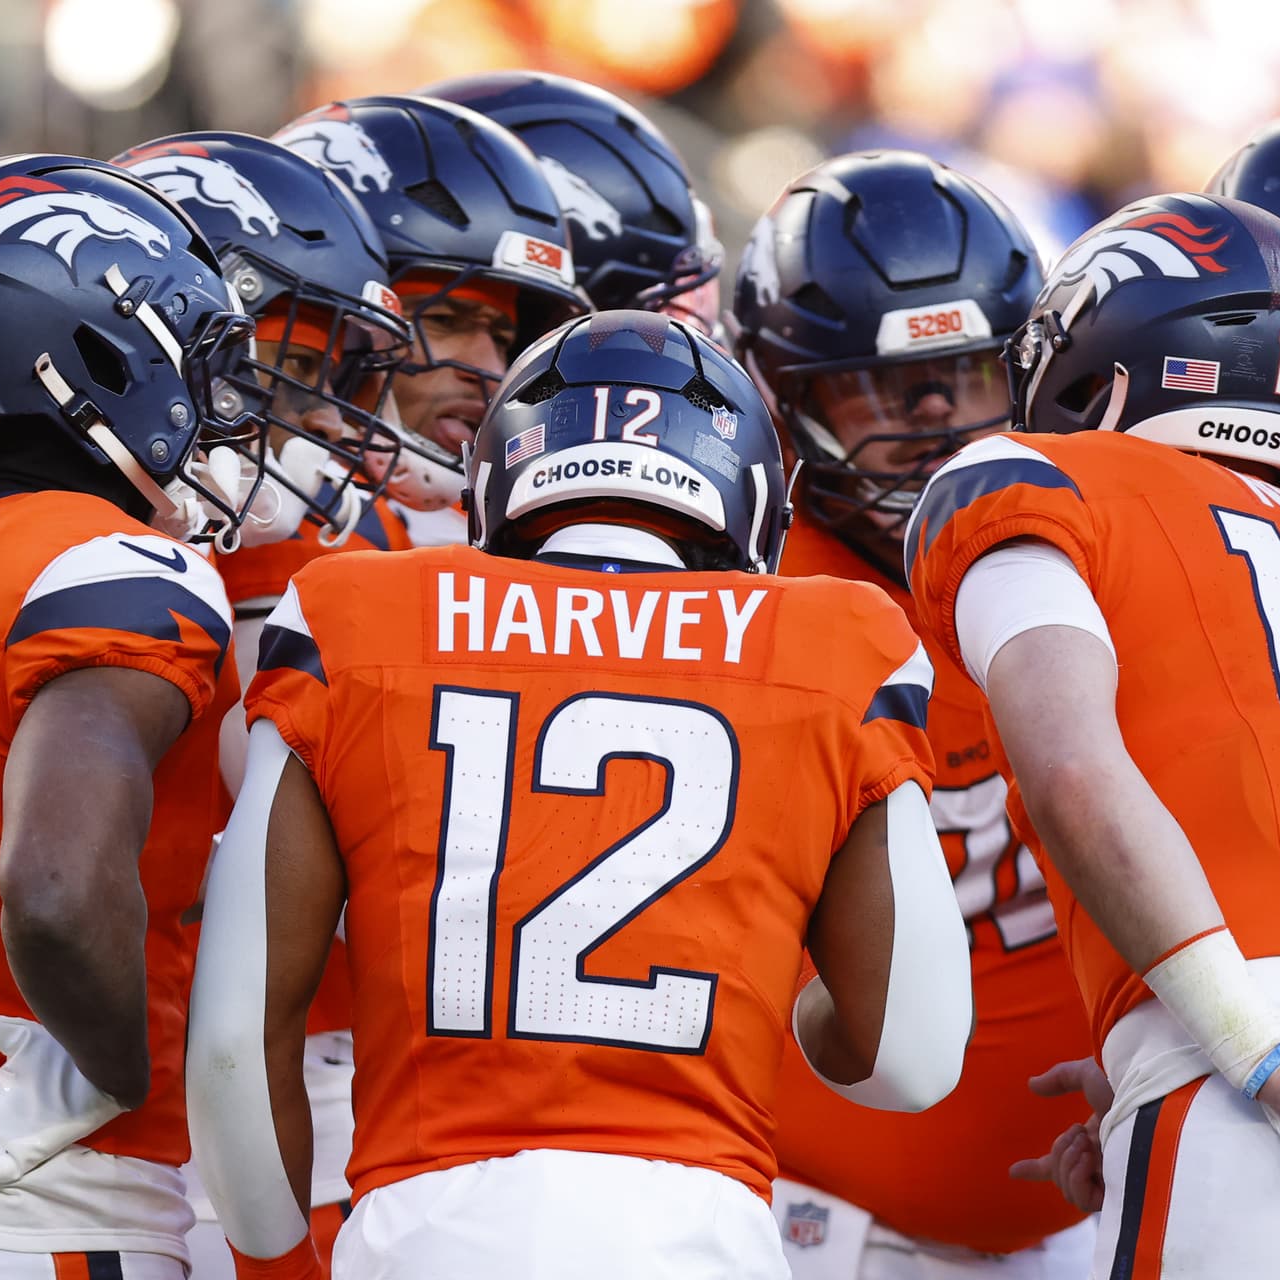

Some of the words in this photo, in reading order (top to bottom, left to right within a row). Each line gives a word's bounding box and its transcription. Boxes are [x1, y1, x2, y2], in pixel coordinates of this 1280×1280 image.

[907, 310, 962, 338] 5280
[592, 385, 662, 449] 12
[716, 415, 733, 435] NFL
[532, 459, 633, 488] CHOOSE
[640, 463, 702, 498] LOVE
[437, 572, 768, 664] HARVEY
[426, 685, 740, 1055] 12
